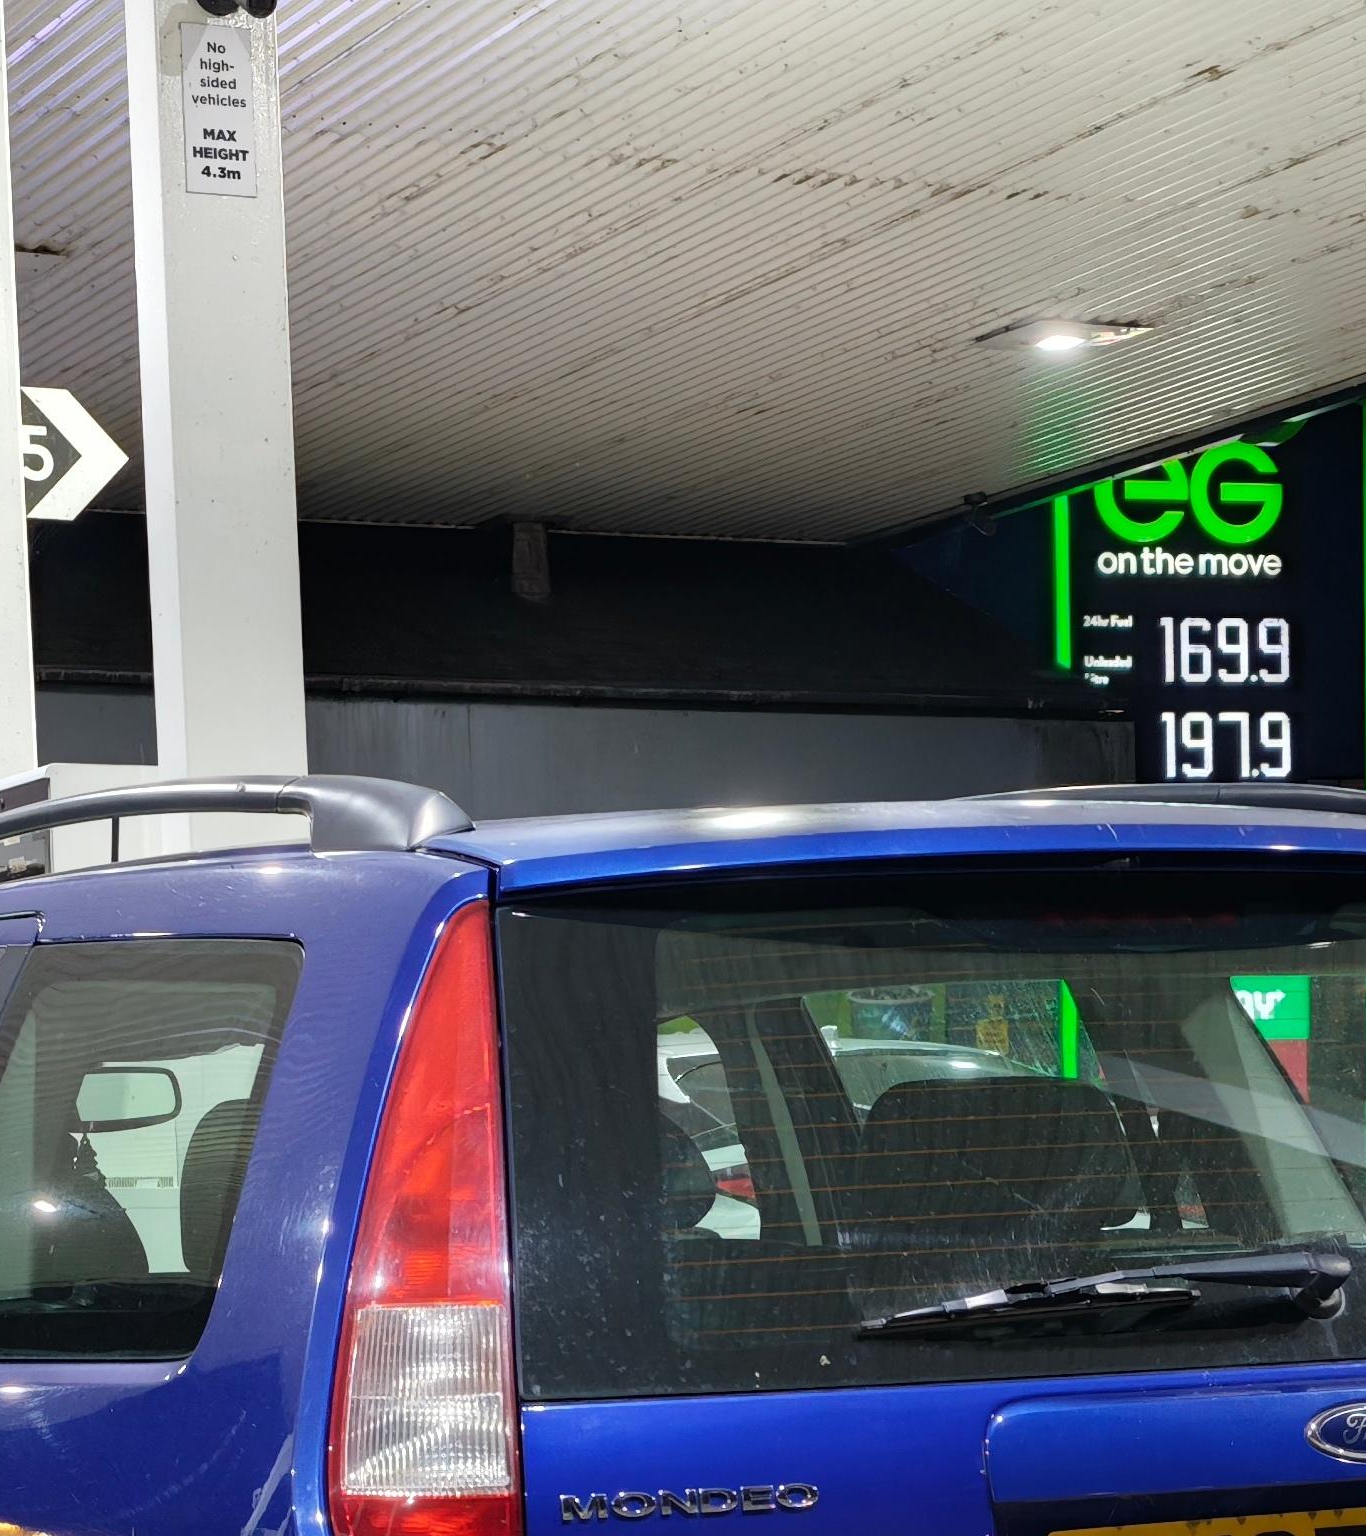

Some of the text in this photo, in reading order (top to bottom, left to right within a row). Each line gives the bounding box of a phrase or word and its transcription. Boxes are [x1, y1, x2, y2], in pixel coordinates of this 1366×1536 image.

[207, 42, 226, 54] No
[200, 58, 234, 72] high-
[200, 76, 236, 89] sided
[192, 94, 246, 107] vehicles
[203, 128, 237, 141] MAX
[192, 146, 249, 161] HEIGHT
[201, 165, 241, 179] 4.3m
[21, 424, 54, 482] 5
[1097, 546, 1282, 576] on the move
[1159, 617, 1290, 683] 169.9
[1160, 711, 1291, 779] 197.9
[559, 1483, 820, 1521] MONDEO
